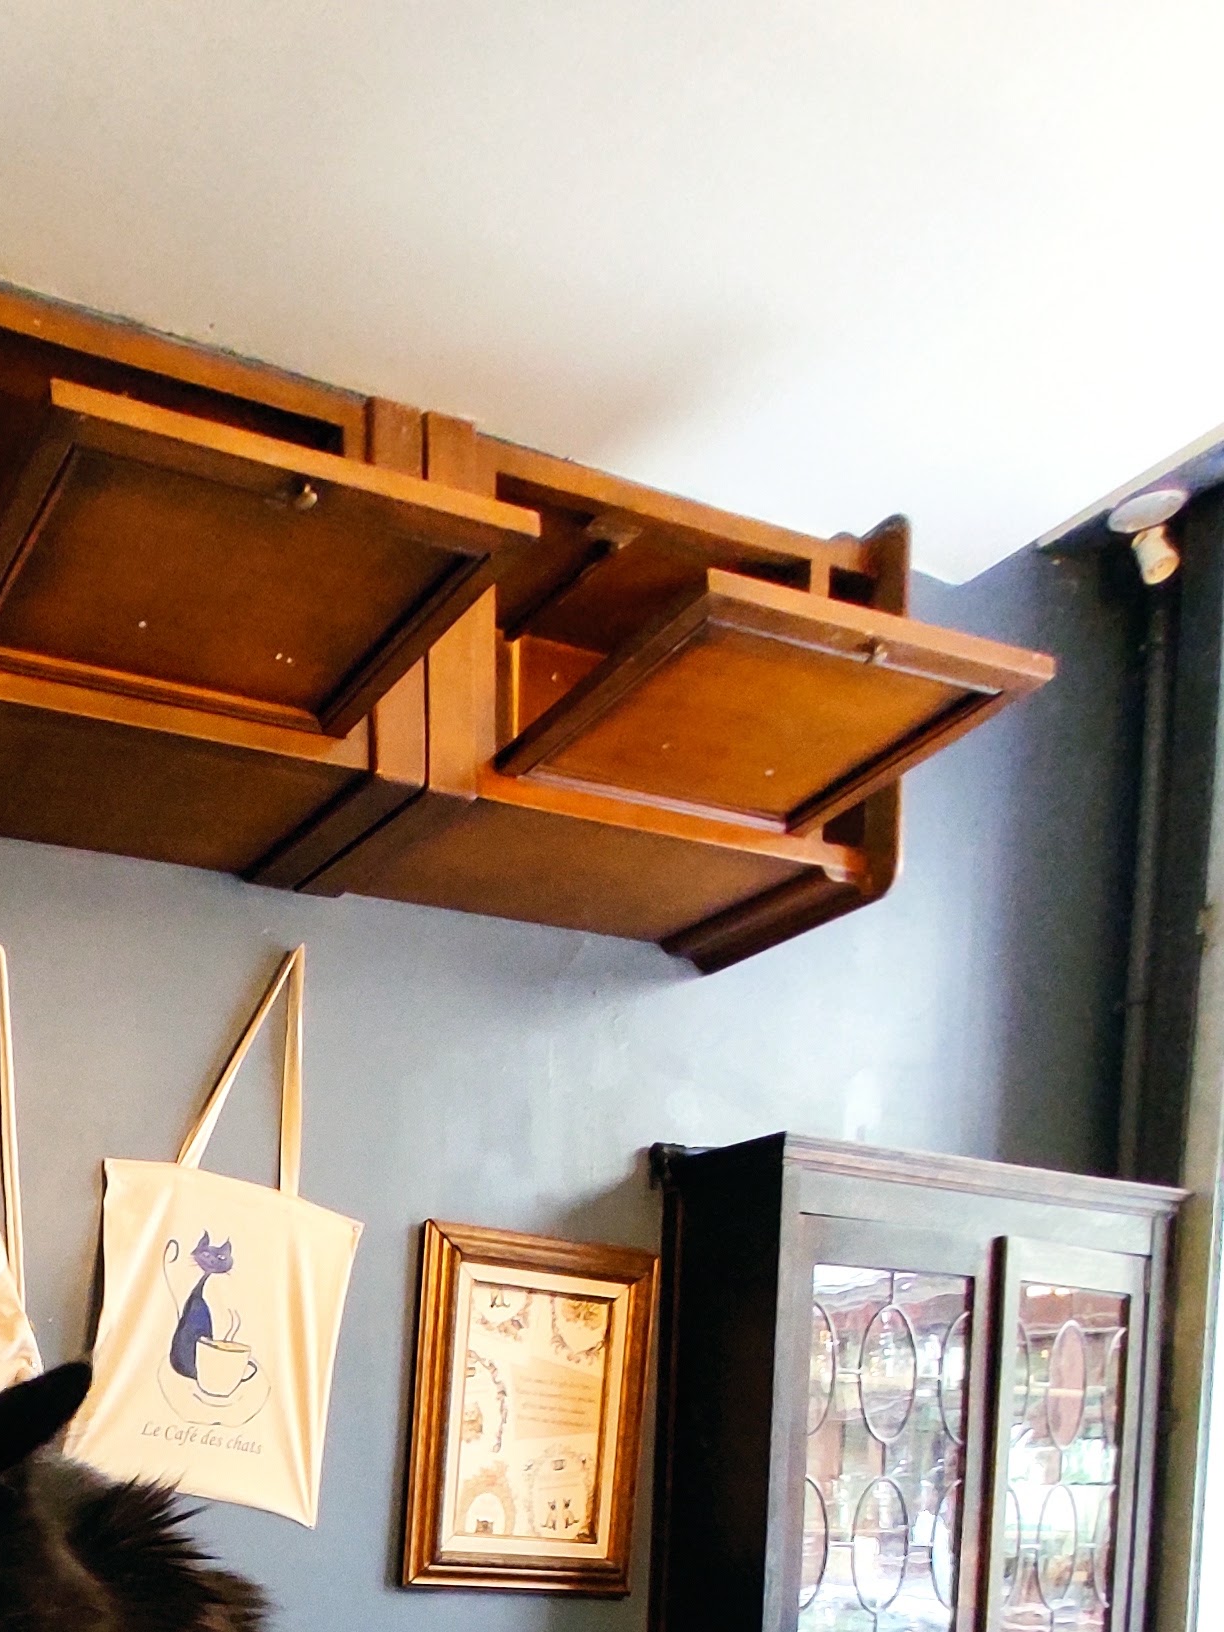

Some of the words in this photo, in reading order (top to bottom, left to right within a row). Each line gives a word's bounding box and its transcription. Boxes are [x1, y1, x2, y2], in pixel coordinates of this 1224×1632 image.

[141, 1421, 161, 1436] Le
[164, 1424, 198, 1446] Café
[200, 1429, 223, 1447] des
[226, 1434, 262, 1454] chats
